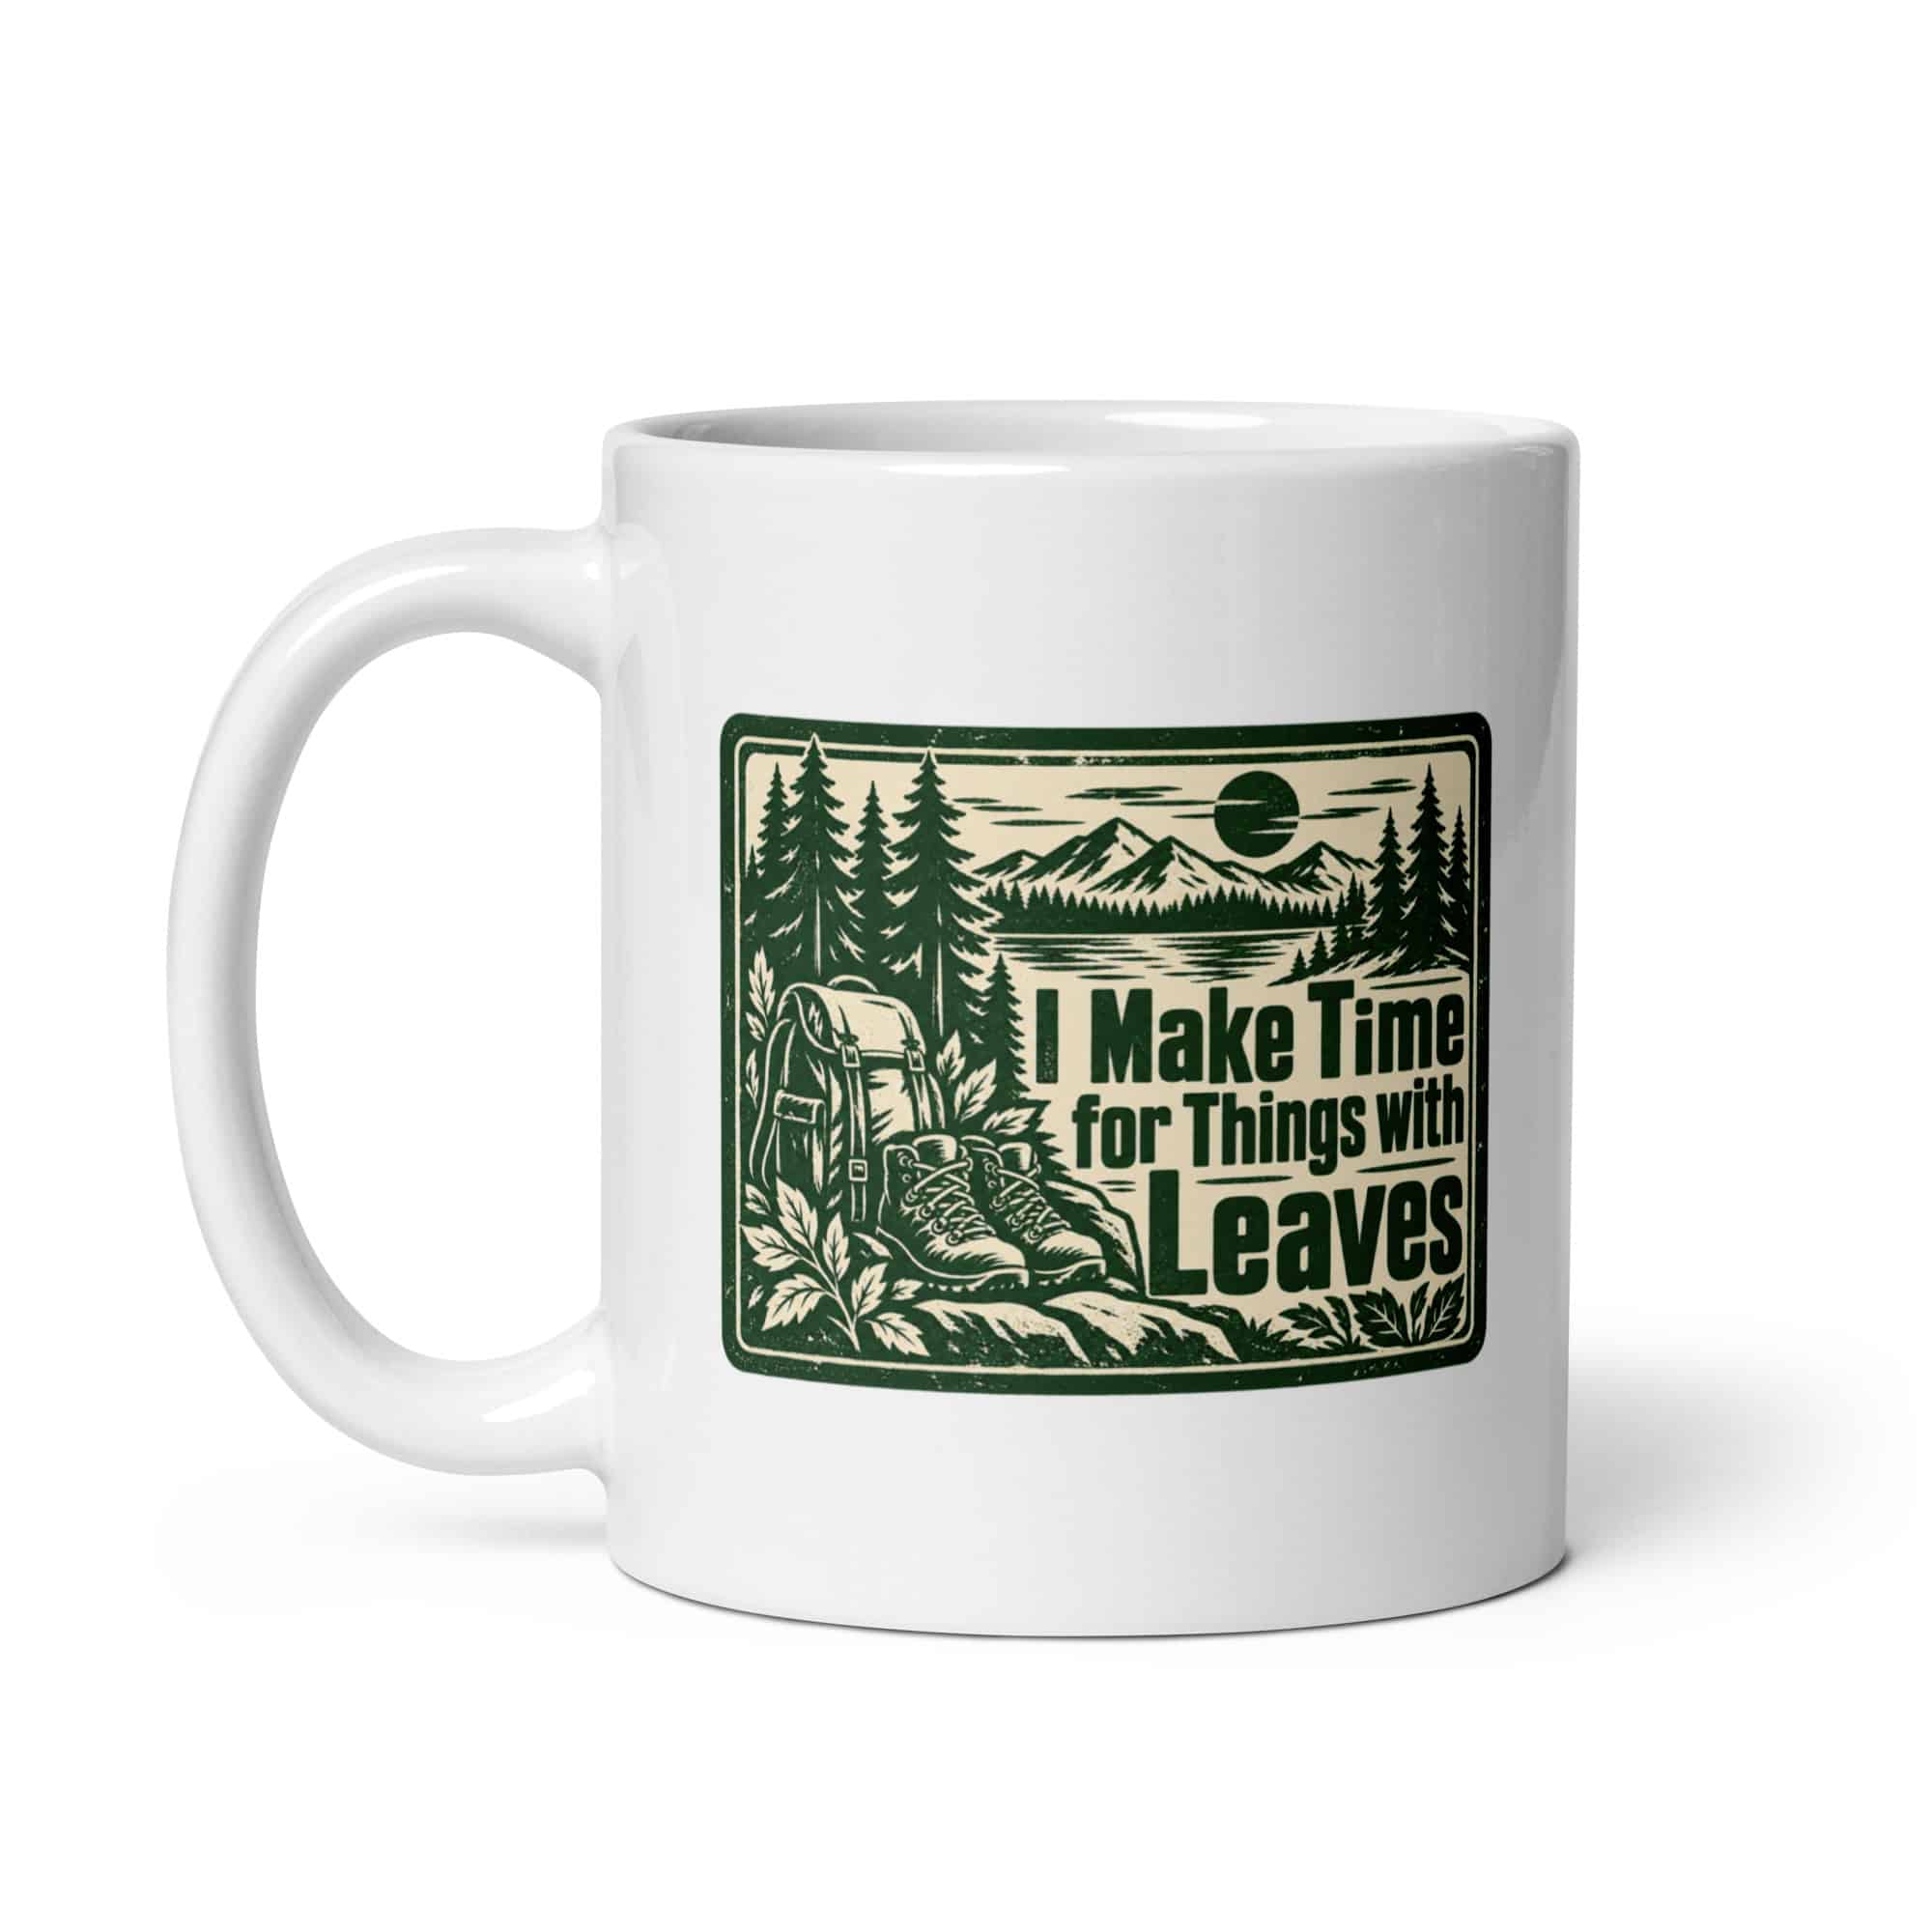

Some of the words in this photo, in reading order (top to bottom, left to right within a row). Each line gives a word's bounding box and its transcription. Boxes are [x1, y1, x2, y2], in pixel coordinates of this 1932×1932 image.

[1036, 988, 1059, 1084] I
[1091, 986, 1294, 1084] Make
[1307, 979, 1465, 1080] Time
[1071, 1094, 1172, 1170] for
[1182, 1090, 1367, 1177] Things
[1375, 1072, 1465, 1154] with
[1149, 1169, 1463, 1296] Leaves
